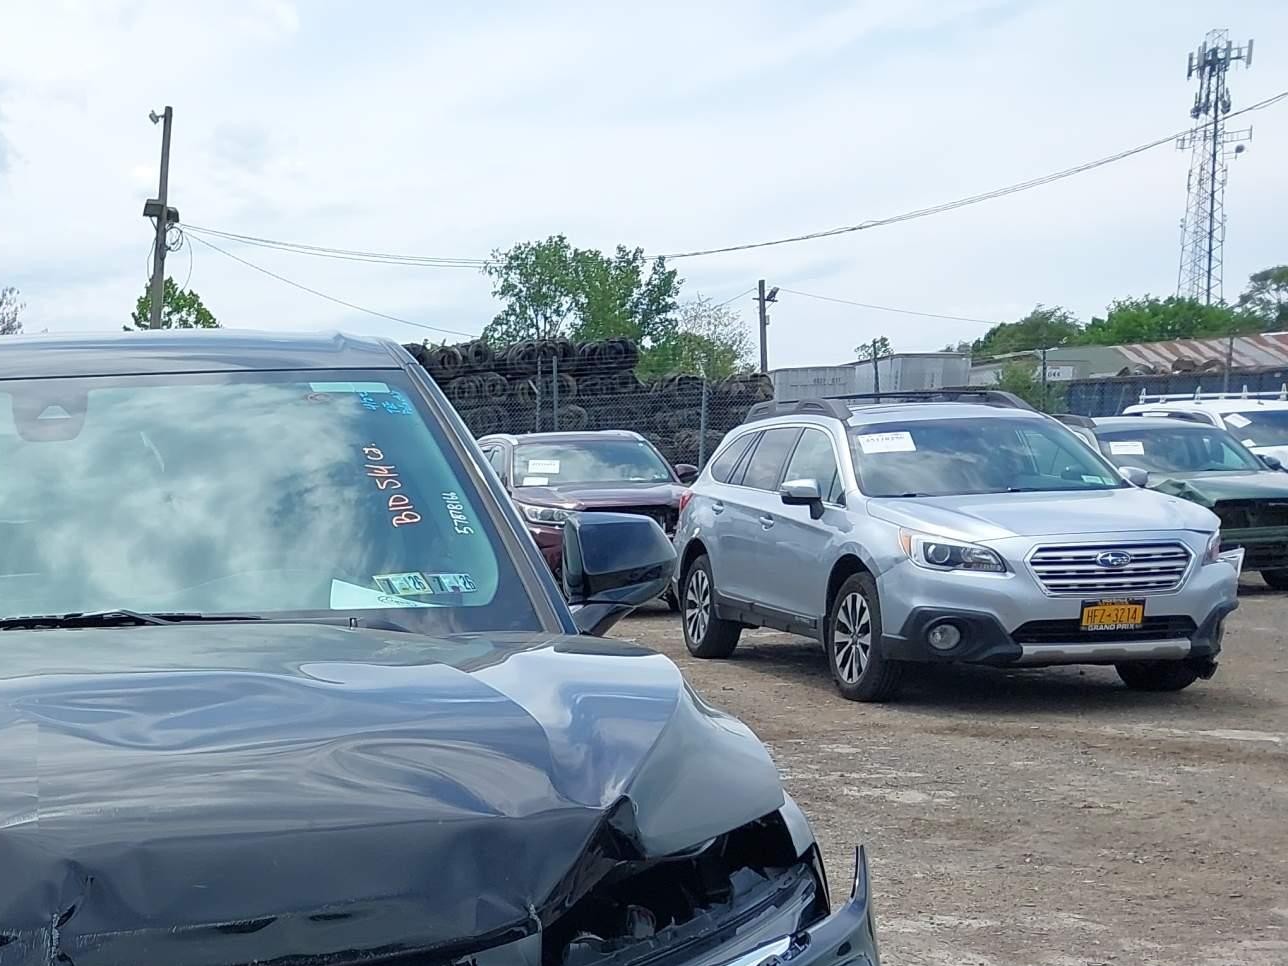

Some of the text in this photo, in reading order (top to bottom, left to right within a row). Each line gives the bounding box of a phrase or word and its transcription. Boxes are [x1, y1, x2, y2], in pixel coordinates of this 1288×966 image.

[388, 494, 421, 527] BID
[408, 575, 427, 590] 26
[459, 575, 477, 590] 26
